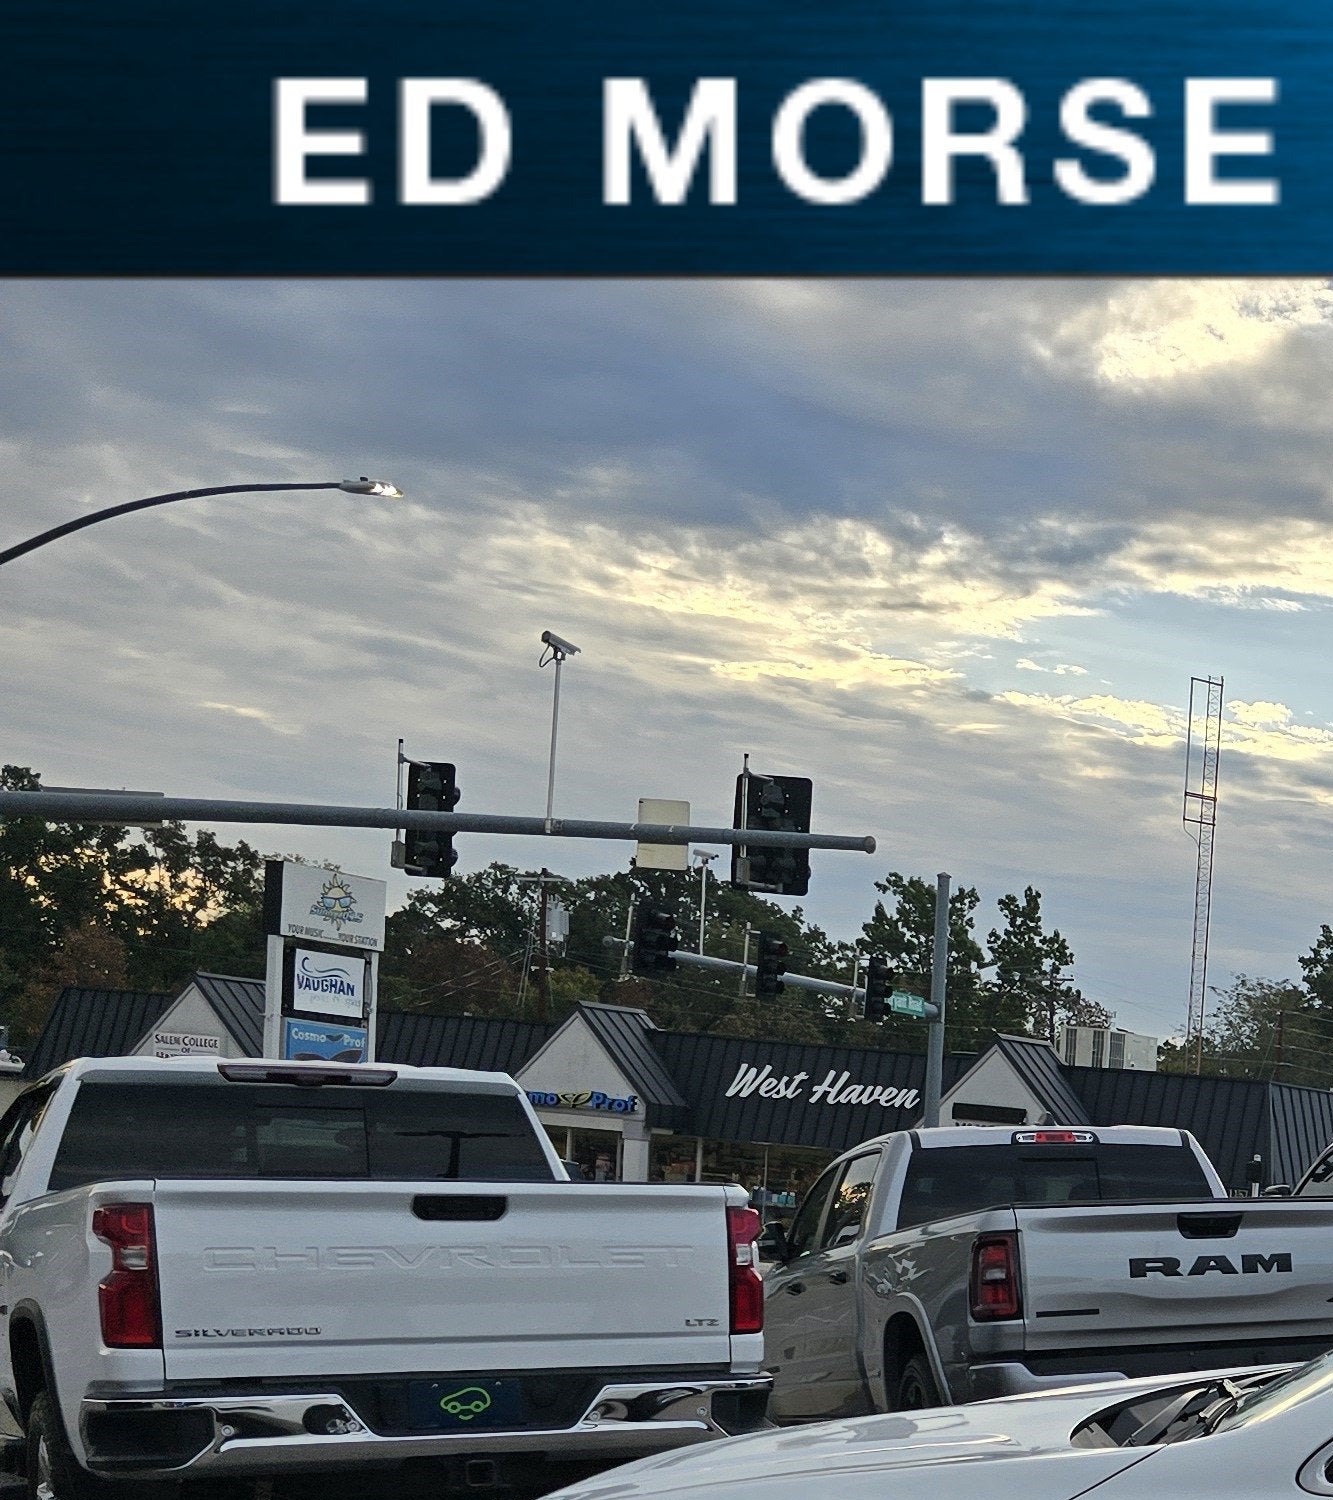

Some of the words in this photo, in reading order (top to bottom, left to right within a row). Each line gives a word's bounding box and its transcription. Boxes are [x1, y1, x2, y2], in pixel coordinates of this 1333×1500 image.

[287, 923, 305, 935] YOUR
[354, 934, 379, 948] STATION
[296, 973, 356, 997] VAUGHAN
[154, 1033, 181, 1046] SALEM
[181, 1035, 219, 1049] COLLEGE
[291, 1027, 327, 1043] Cosmo
[342, 1033, 366, 1049] Prof
[725, 1062, 809, 1100] West
[809, 1070, 921, 1109] Haven
[591, 1090, 639, 1113] Prof
[201, 1244, 694, 1273] CHEVROLET
[1128, 1252, 1294, 1279] RAM
[174, 1326, 322, 1338] SILVERADO
[685, 1318, 719, 1327] LTZ
